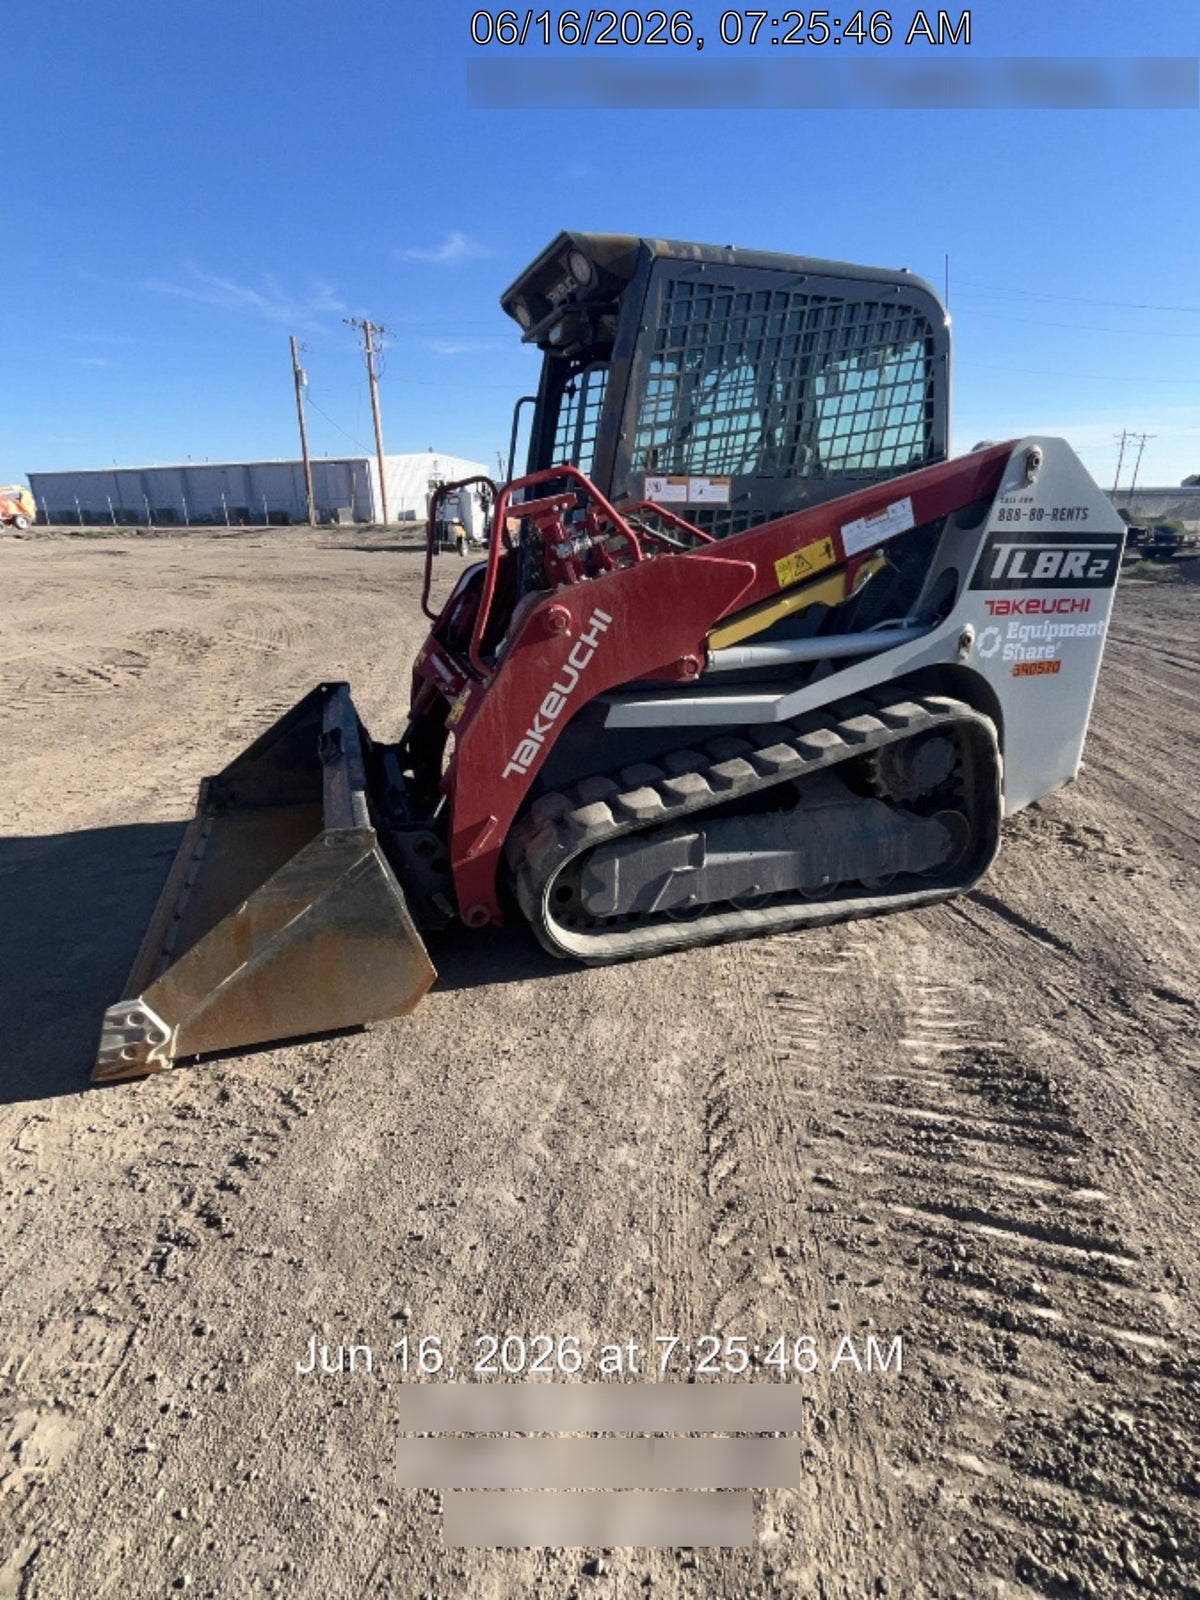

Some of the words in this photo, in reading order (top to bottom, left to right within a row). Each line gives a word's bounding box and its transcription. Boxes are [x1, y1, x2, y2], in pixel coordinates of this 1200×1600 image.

[998, 507, 1089, 522] 888-80-RENTS
[1006, 620, 1105, 642] Equipment
[1002, 643, 1056, 661] Share
